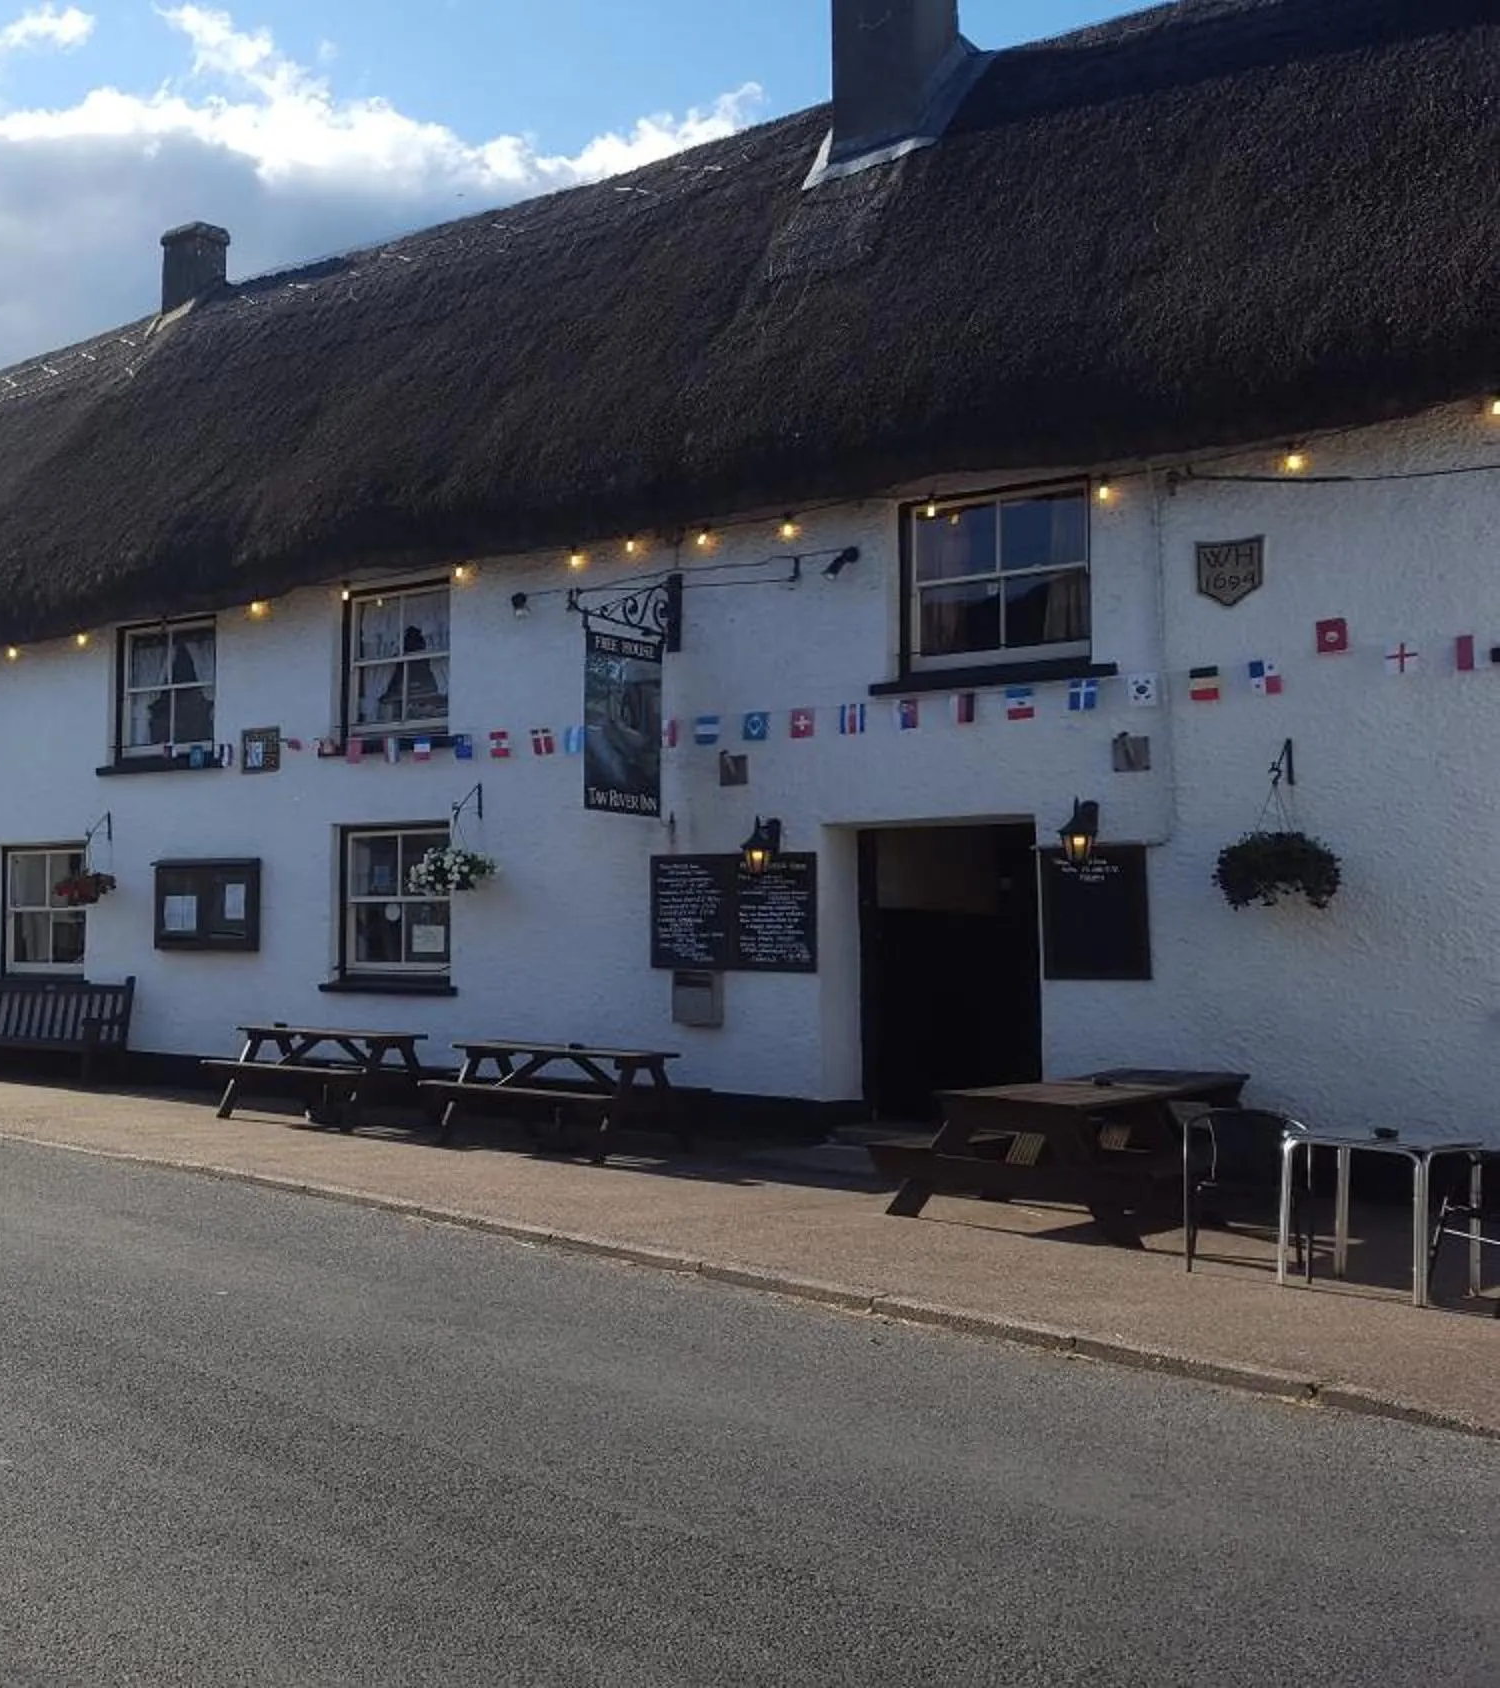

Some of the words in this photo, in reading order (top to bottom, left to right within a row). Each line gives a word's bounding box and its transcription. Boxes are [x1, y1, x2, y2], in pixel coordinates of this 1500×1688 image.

[1200, 545, 1253, 568] WH
[595, 635, 619, 652] FREE
[622, 641, 655, 658] HOUSE
[609, 789, 639, 809] RIVER
[640, 793, 657, 811] INN
